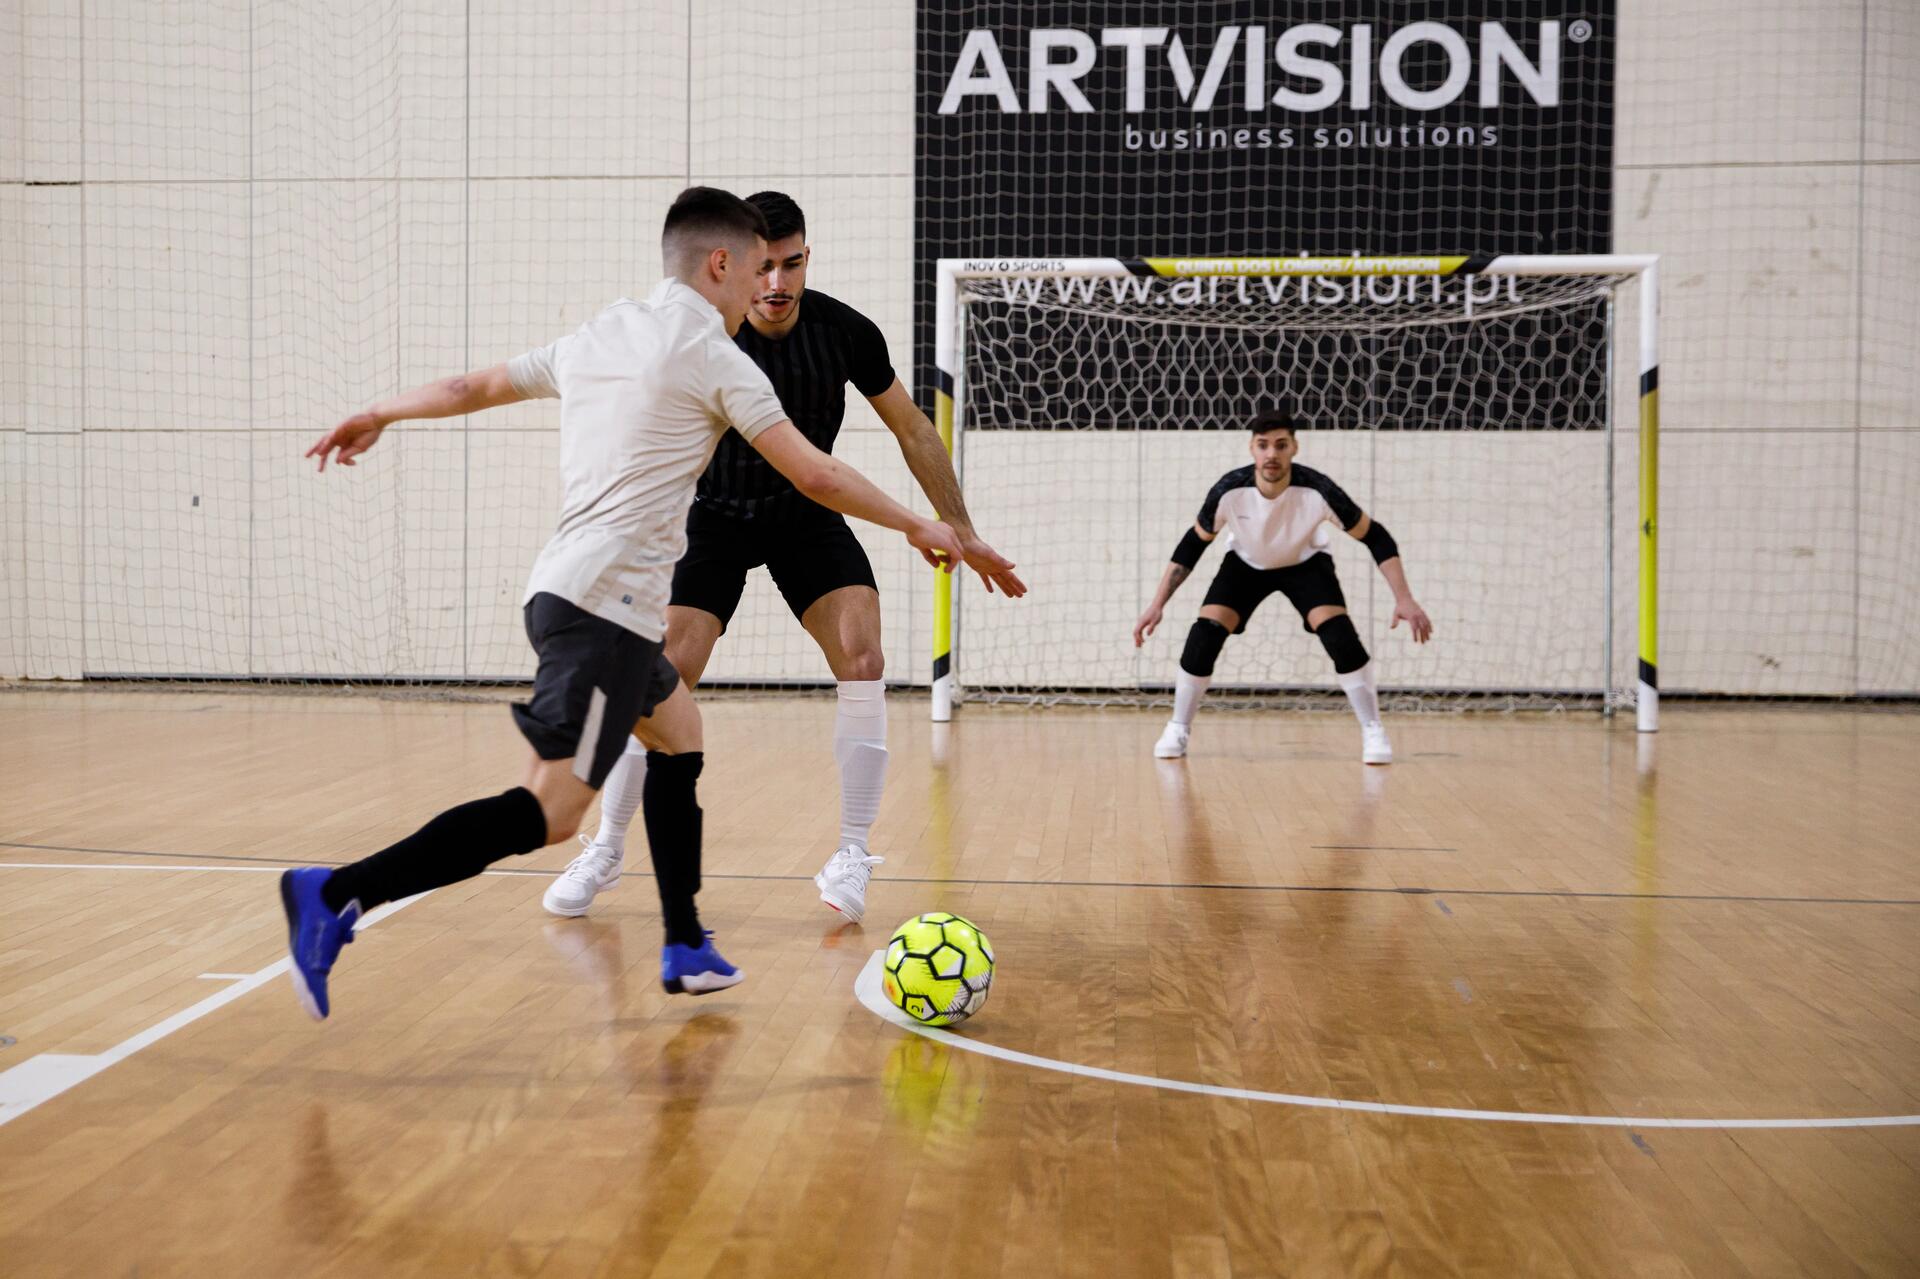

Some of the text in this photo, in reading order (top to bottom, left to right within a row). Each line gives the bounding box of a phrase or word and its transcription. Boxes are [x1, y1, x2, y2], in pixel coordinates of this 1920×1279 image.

[937, 20, 1561, 114] ARTVISION
[1125, 120, 1498, 150] business solutions
[964, 261, 995, 271] INOV
[1013, 261, 1065, 271] SPORTS
[1175, 260, 1234, 273] QUINTA
[1239, 260, 1271, 273] DOS
[1001, 250, 1523, 317] www.artvision.pt
